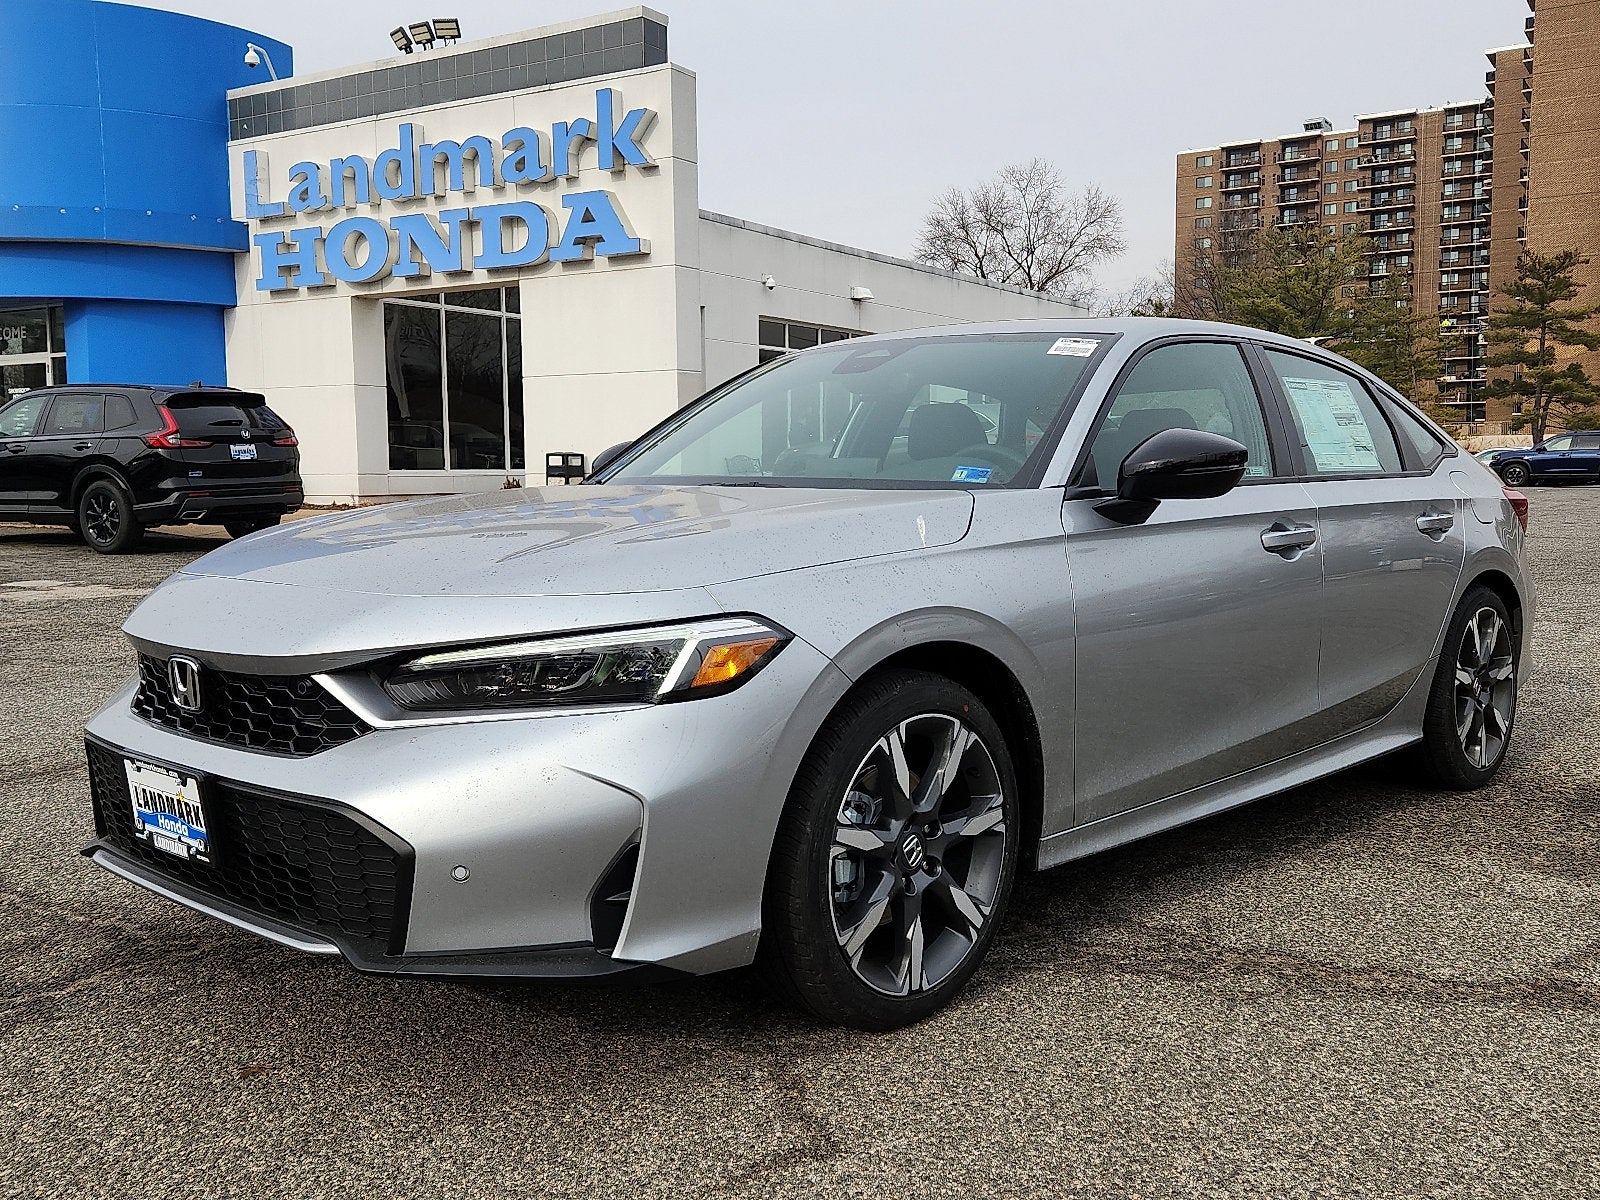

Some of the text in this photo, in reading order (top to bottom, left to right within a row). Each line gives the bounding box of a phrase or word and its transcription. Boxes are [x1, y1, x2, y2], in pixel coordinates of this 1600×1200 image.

[243, 88, 655, 219] Landmark
[254, 190, 646, 291] HONDA
[134, 785, 204, 828] LANDMARK
[158, 814, 188, 836] Honda
